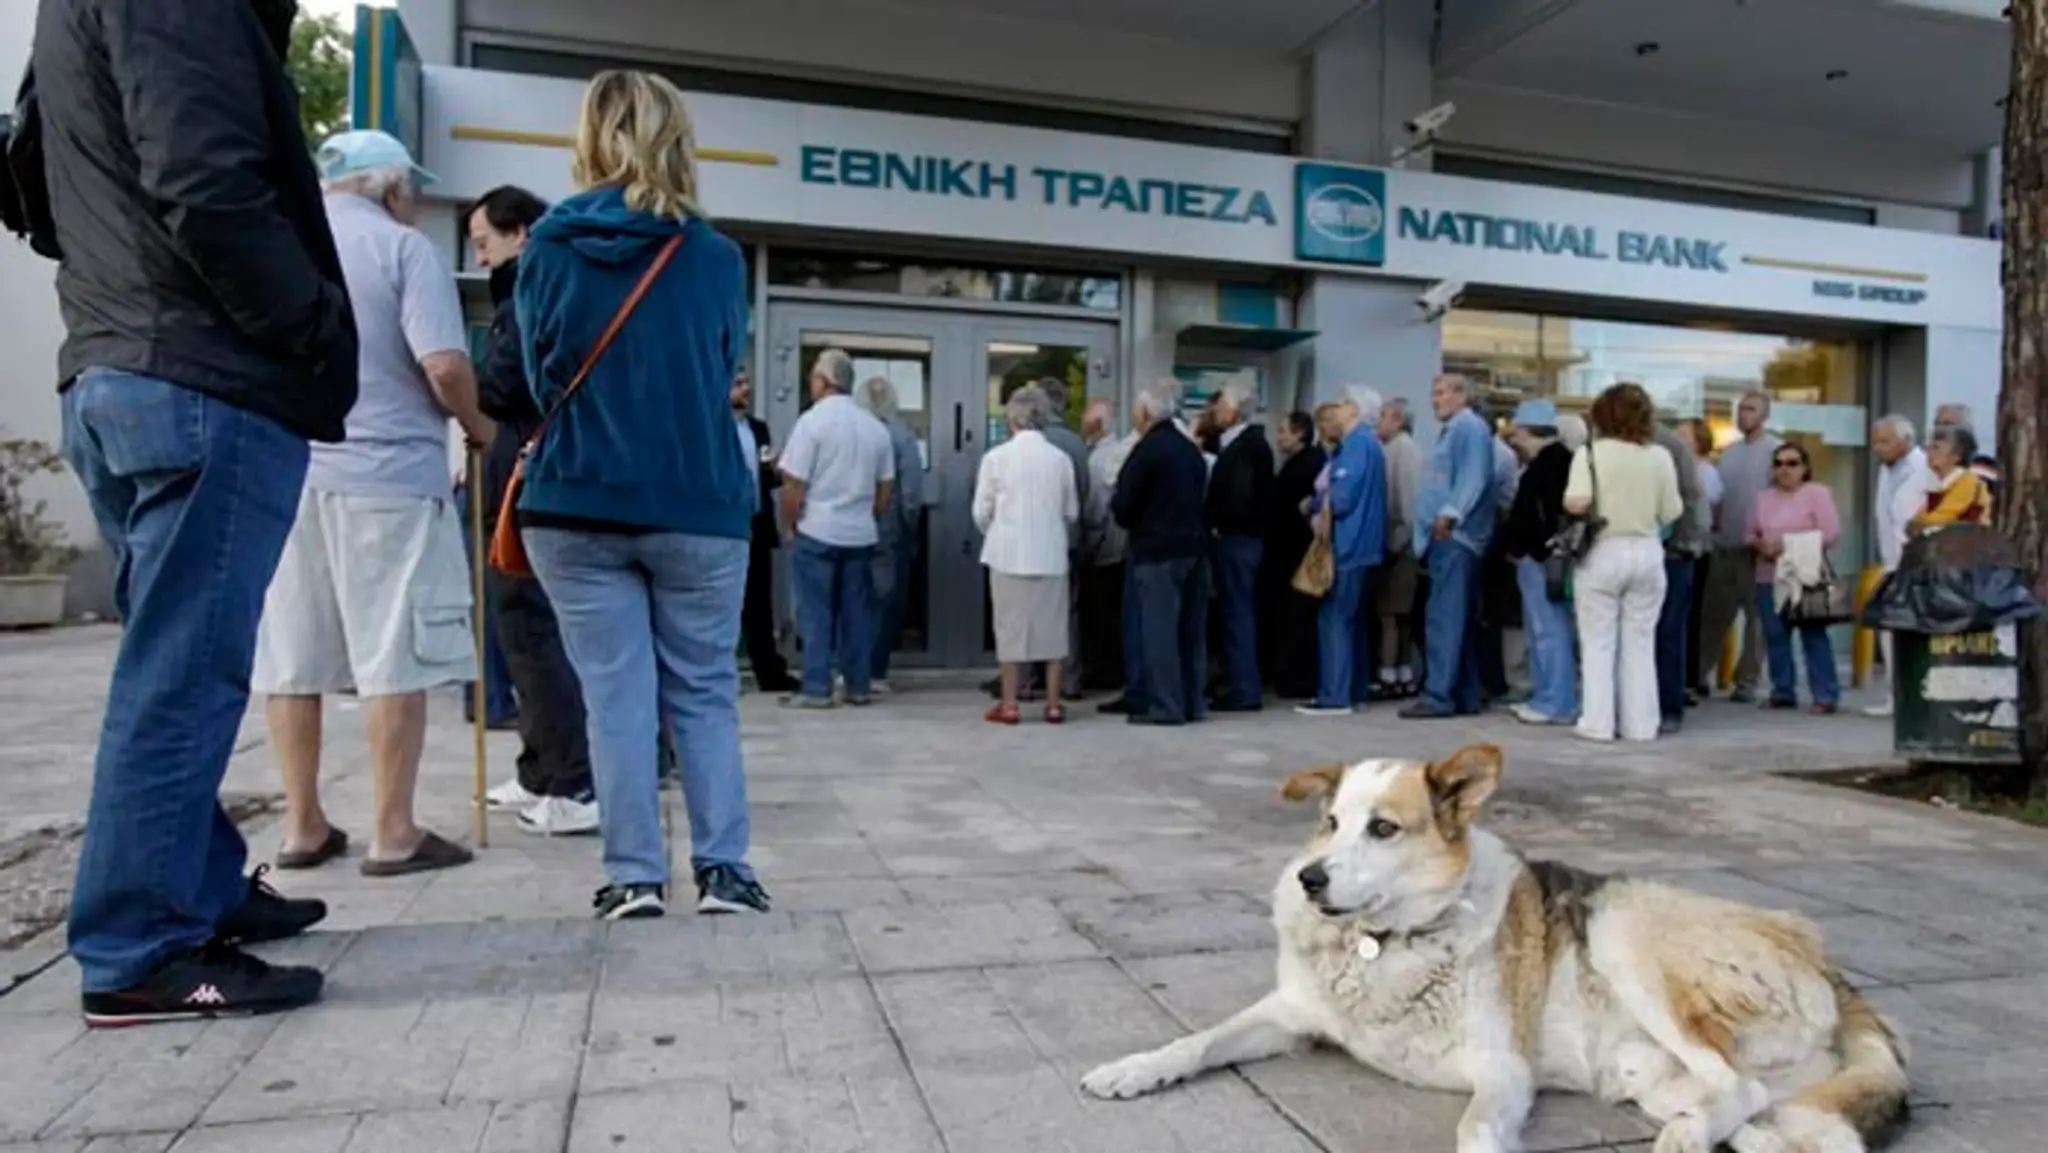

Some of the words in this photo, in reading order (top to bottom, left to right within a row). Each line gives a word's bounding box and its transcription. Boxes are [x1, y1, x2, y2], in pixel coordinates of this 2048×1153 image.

[801, 146, 1016, 200] ΕΘΝΙΚΗ
[1033, 168, 1277, 226] ΤΡΑΠΕΖΑ
[1398, 206, 1609, 259] NATIONAL
[1617, 230, 1729, 273] BANK
